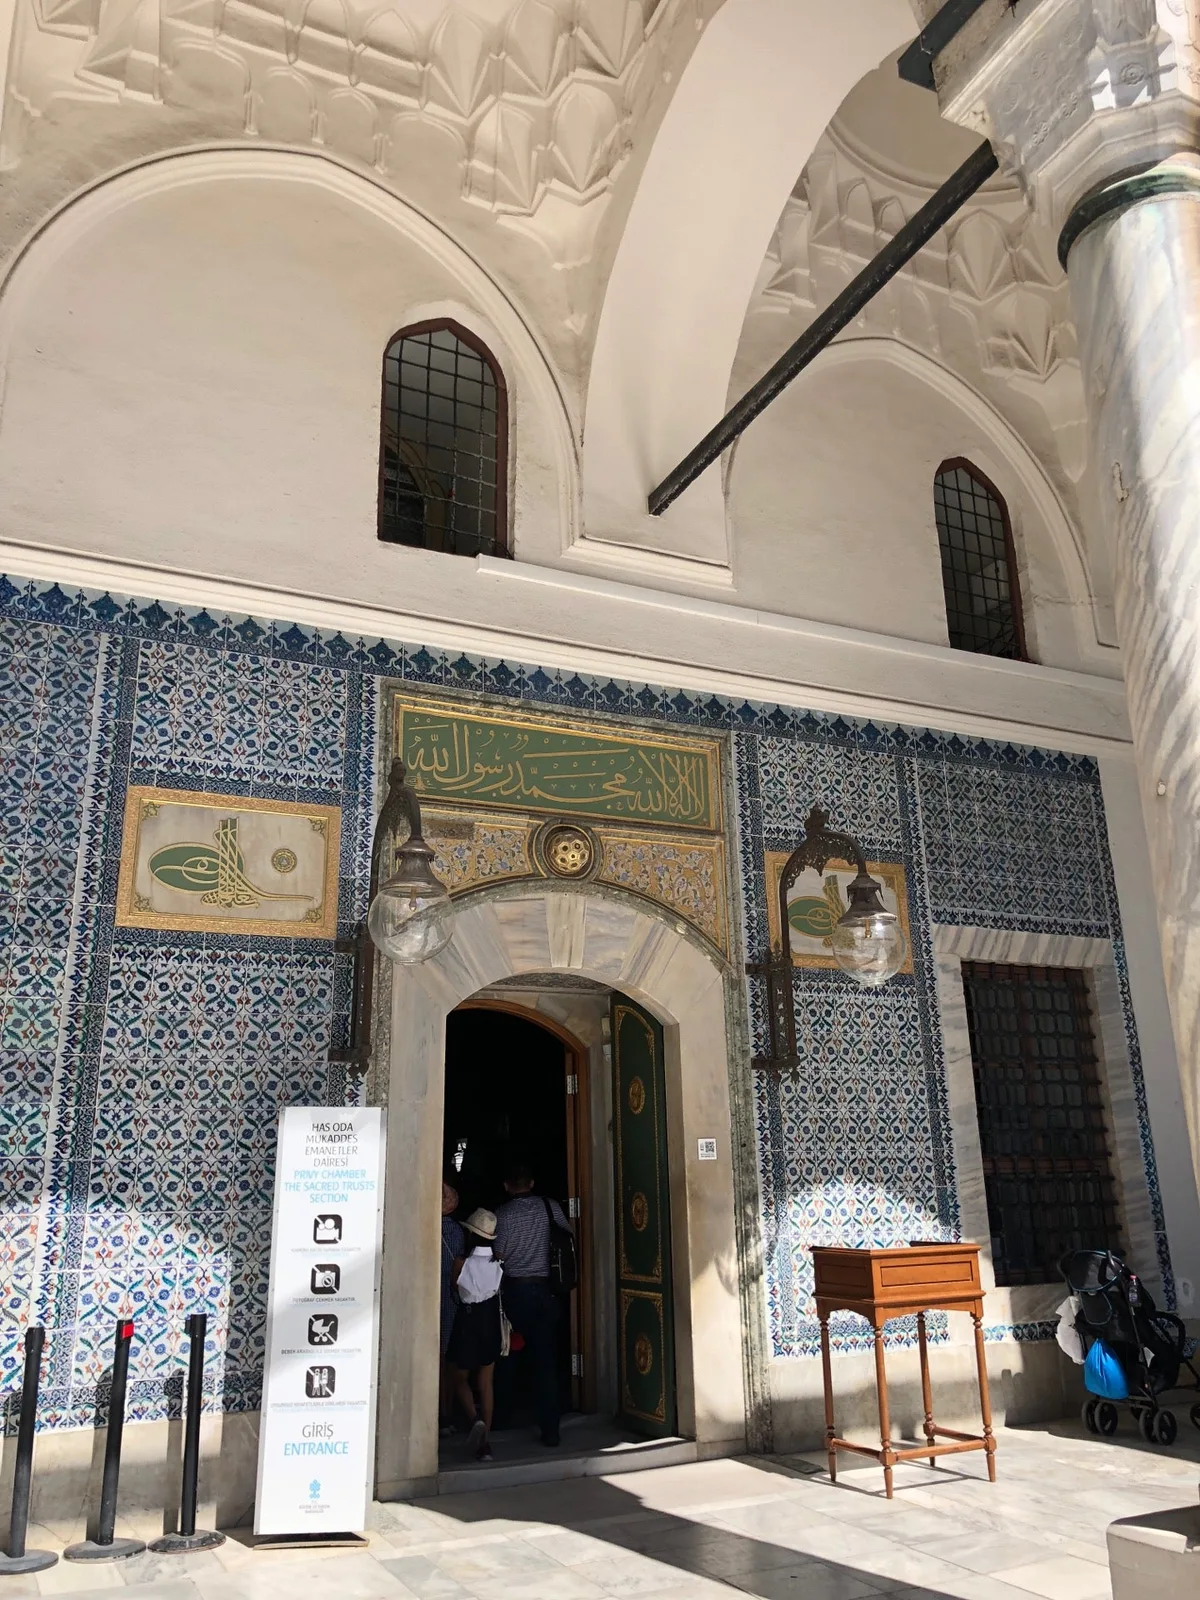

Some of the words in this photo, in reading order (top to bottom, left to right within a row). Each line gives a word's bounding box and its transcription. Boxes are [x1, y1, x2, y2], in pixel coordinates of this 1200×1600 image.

[312, 1122, 331, 1132] HAS
[332, 1122, 353, 1132] ODA
[305, 1134, 358, 1144] MUKADDES
[304, 1146, 358, 1156] EMANETLER
[293, 1170, 319, 1180] PRIVY
[321, 1169, 367, 1180] CHAMBER
[284, 1182, 301, 1192] THE
[303, 1181, 340, 1192] SACRED
[342, 1180, 376, 1191] TRUSTS
[310, 1193, 348, 1204] SECTION
[302, 1421, 334, 1440] GİRİŞ
[284, 1441, 349, 1456] ENTRANCE
